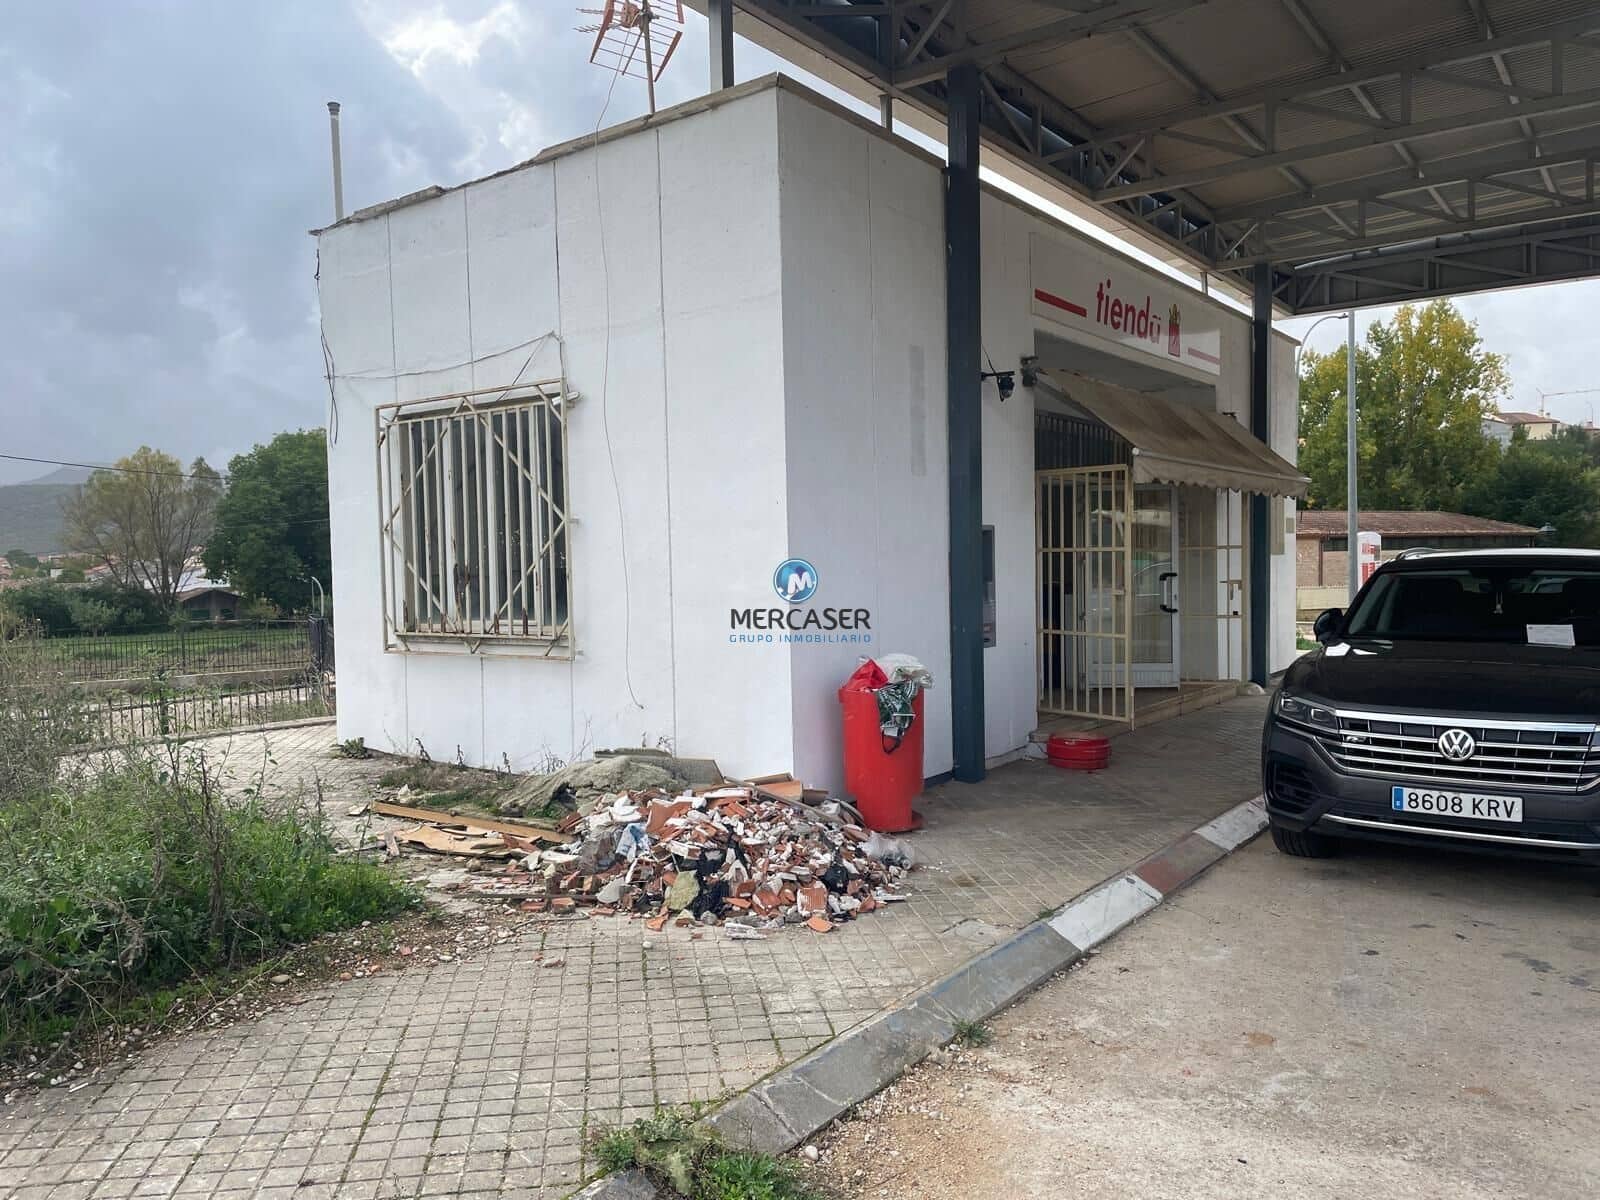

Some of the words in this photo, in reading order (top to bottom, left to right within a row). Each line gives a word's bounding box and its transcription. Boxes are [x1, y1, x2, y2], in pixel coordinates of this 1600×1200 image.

[1096, 278, 1161, 344] tienda
[1407, 792, 1463, 813] 8608
[1472, 797, 1515, 818] KRV
